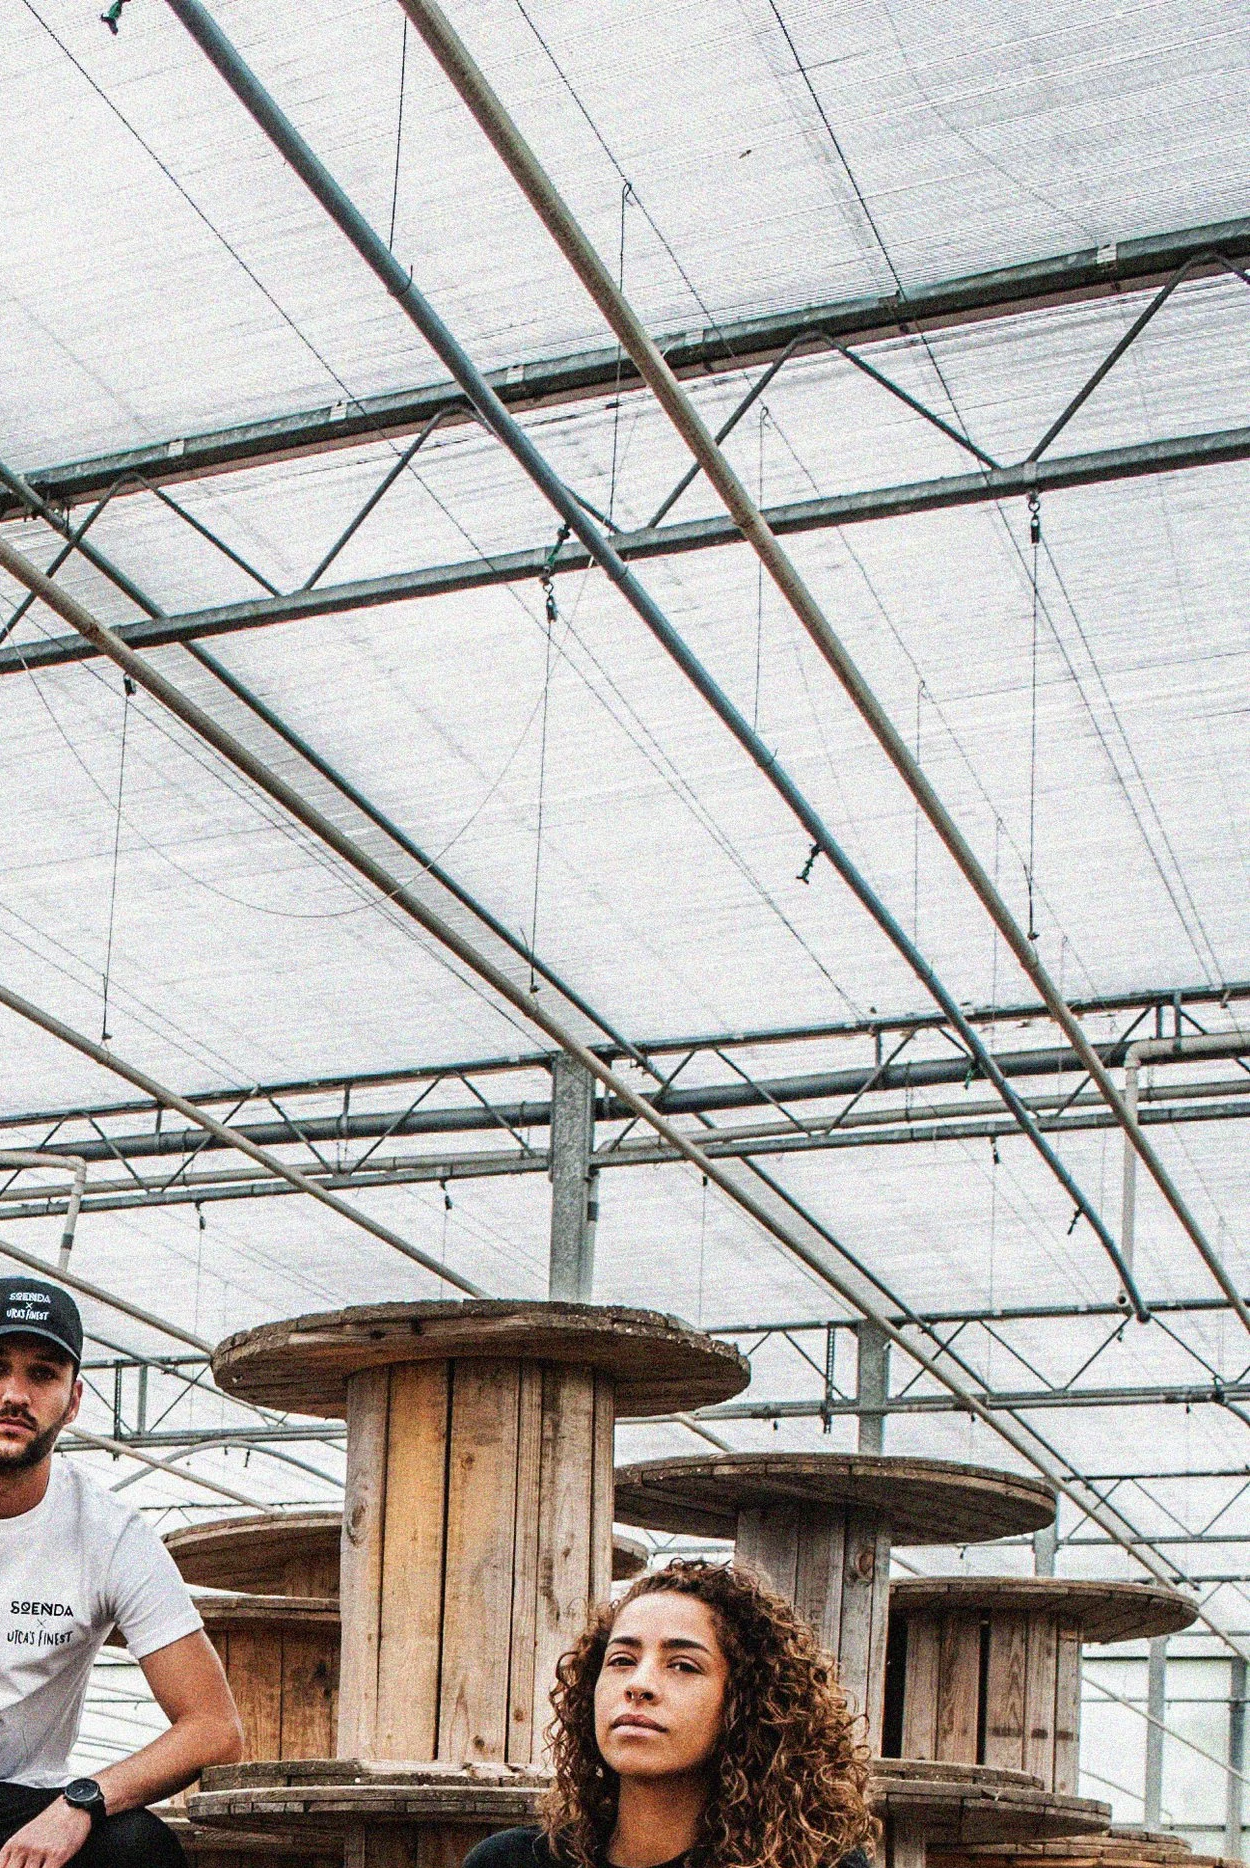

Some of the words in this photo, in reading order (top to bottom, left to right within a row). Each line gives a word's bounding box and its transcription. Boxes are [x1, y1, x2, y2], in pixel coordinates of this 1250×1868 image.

[9, 1292, 51, 1303] SOENDA
[10, 1601, 73, 1617] SOENDA
[38, 1630, 73, 1646] FINEST
